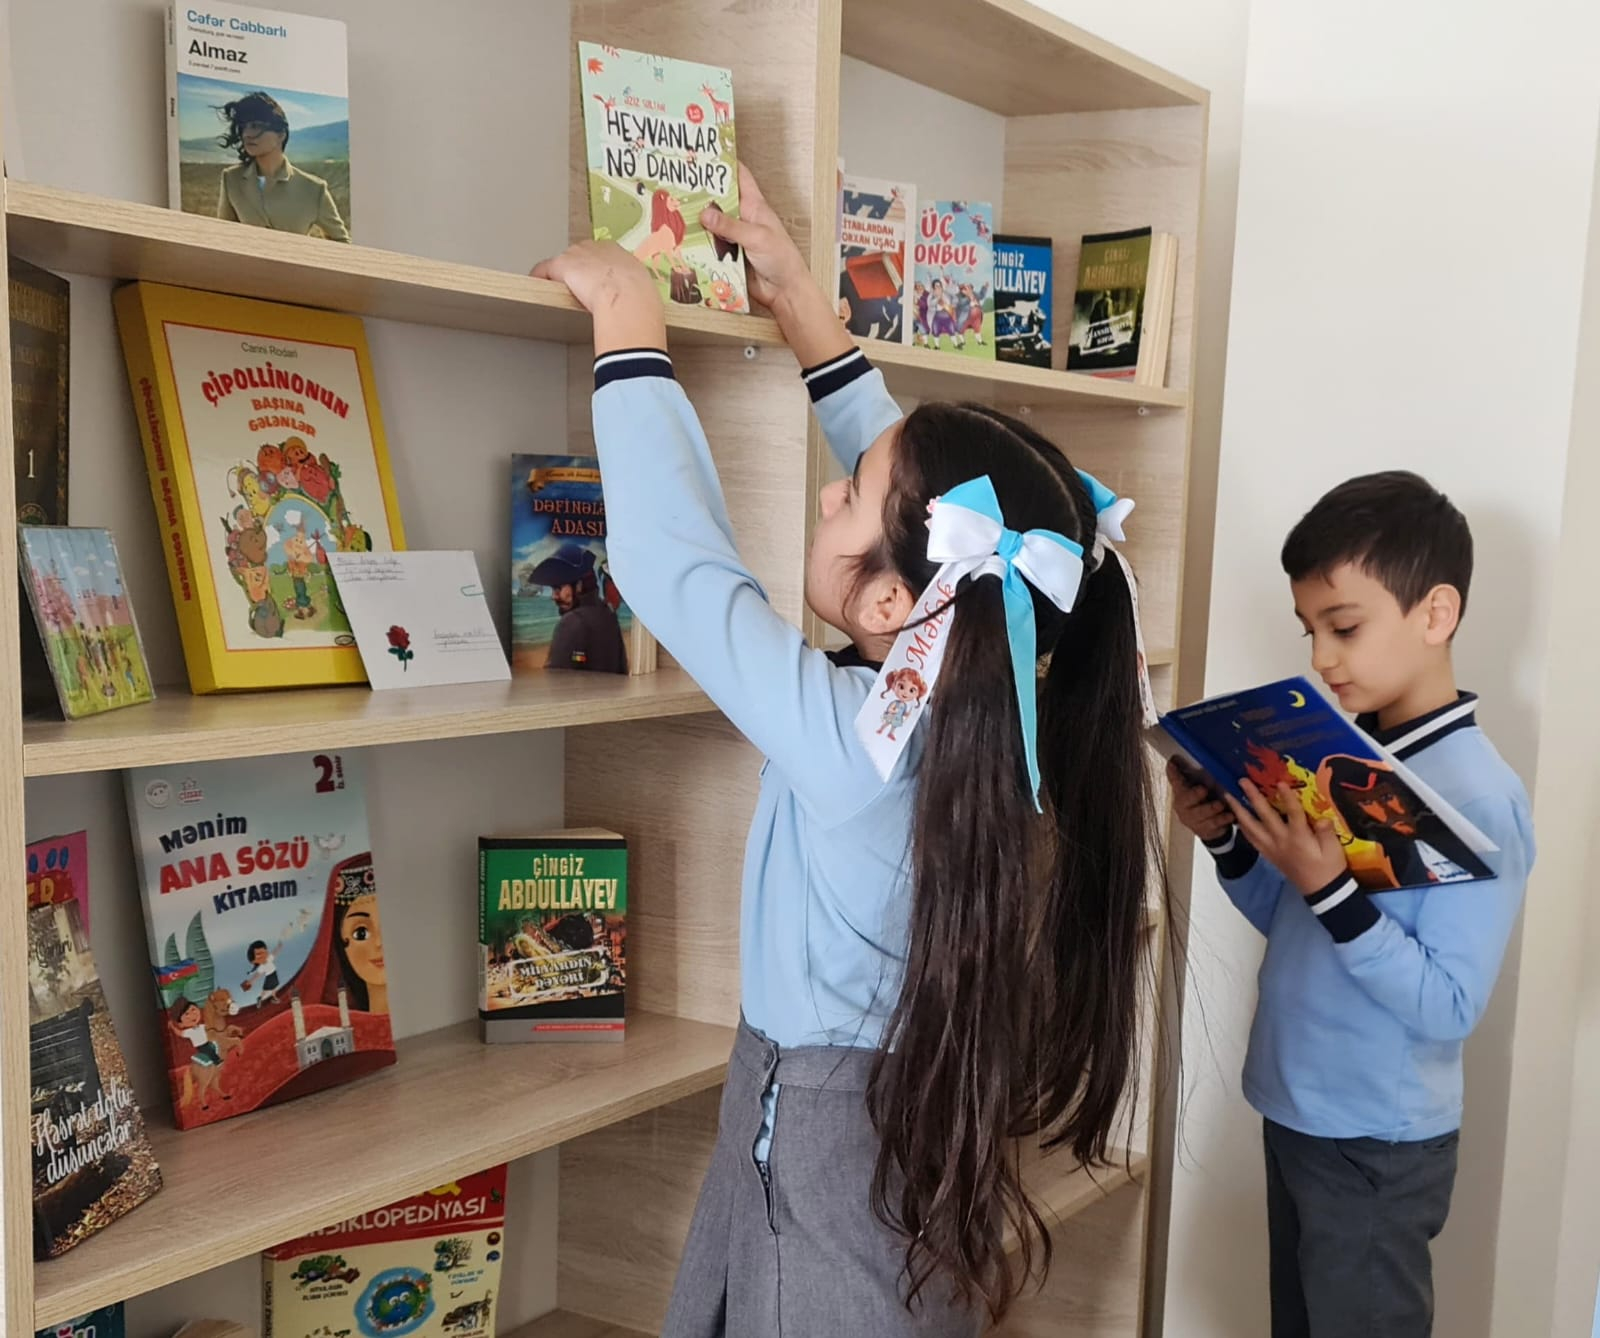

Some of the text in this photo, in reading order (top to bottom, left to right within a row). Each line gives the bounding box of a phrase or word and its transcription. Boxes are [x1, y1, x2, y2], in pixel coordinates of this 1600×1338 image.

[229, 18, 287, 38] Cabbarlı
[188, 39, 248, 64] Almaz
[606, 109, 719, 156] HEYVANLAR
[606, 148, 728, 194] NƏ DANIŞIR?
[843, 217, 895, 237] İTABLARDAN
[921, 207, 953, 242] ÜÇ
[842, 231, 896, 250] ORXAN UŞAQ
[914, 244, 977, 266] ONBUL
[994, 267, 1047, 295] ULLAYEV
[201, 361, 350, 420] ÇİPOLLİNONUN
[251, 396, 306, 415] BAŞINA
[27, 448, 36, 479] 1
[552, 518, 605, 537] ADASI
[313, 754, 336, 793] 2
[160, 836, 310, 894] ANA SÖZÜ
[533, 853, 584, 879] ÇİNGİZ
[498, 879, 617, 911] ABDULLAYEV
